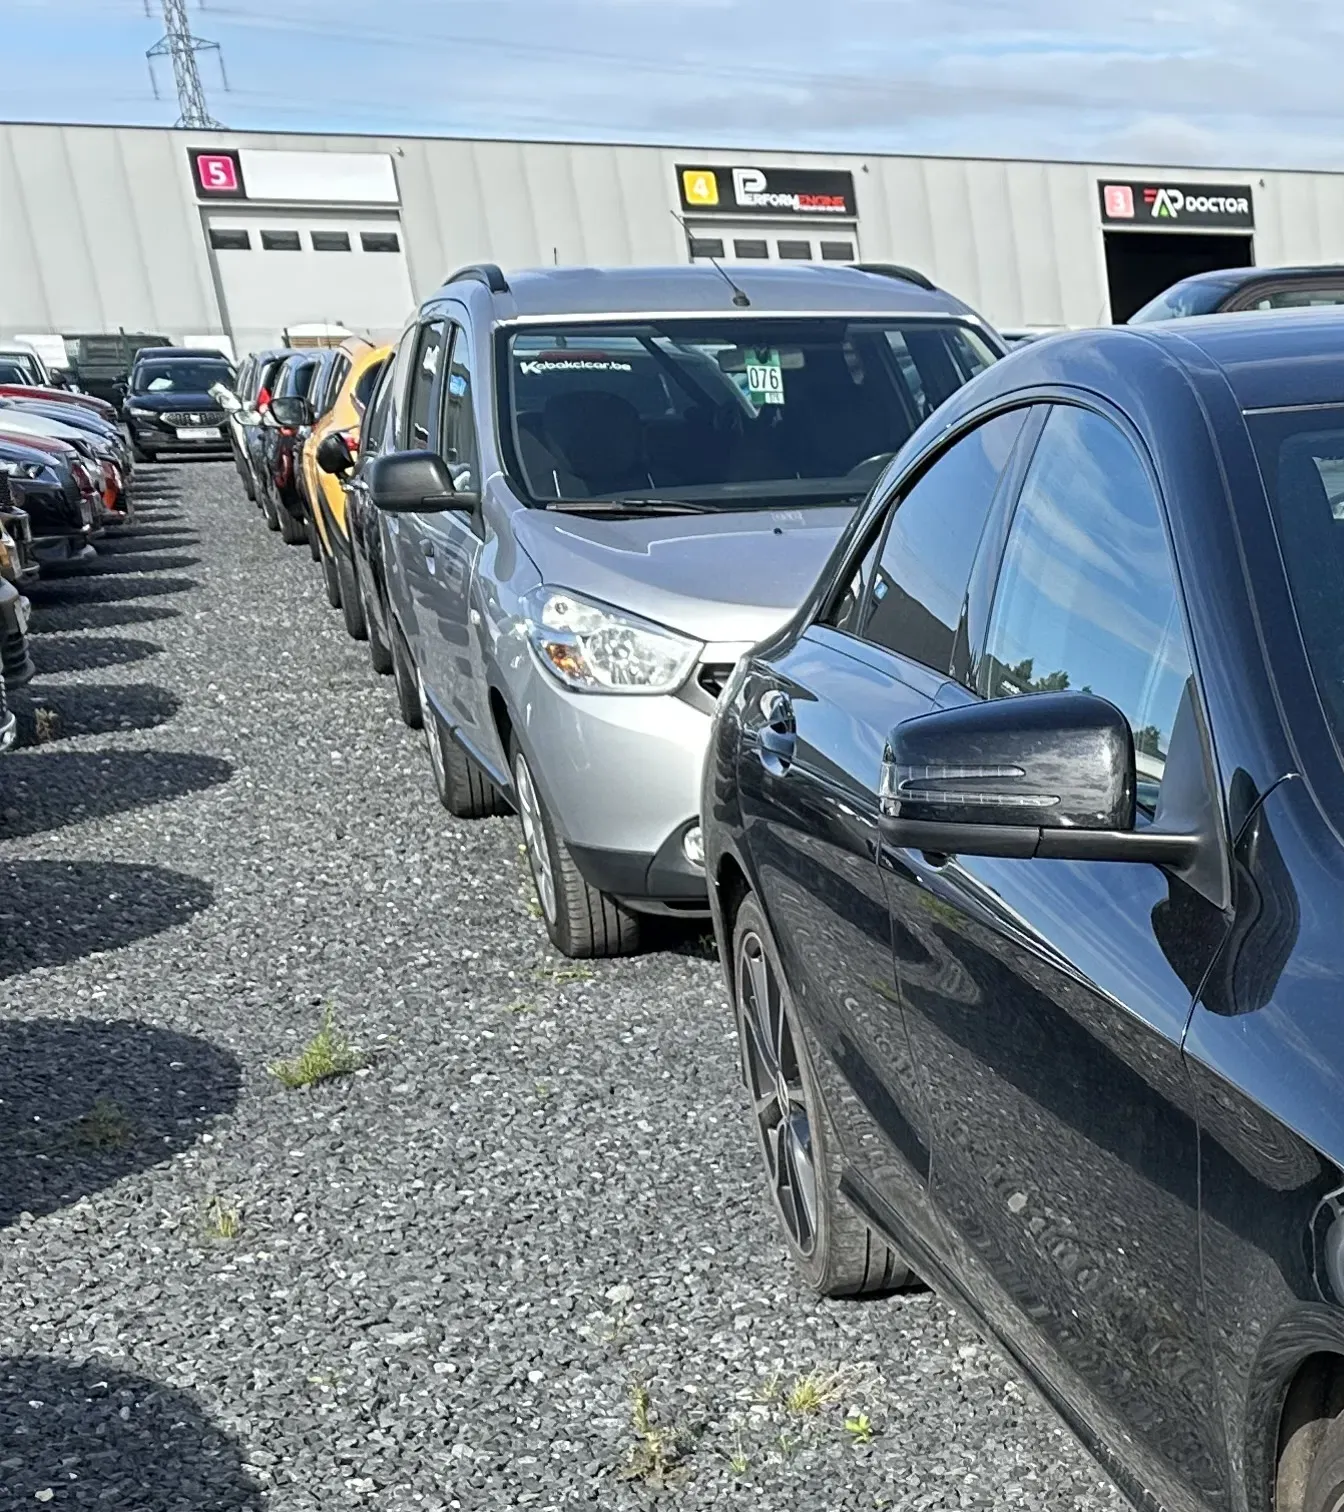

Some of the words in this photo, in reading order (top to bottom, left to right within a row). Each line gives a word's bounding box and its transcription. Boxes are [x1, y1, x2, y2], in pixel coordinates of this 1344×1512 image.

[209, 161, 227, 185] 5
[692, 176, 710, 198] 4
[1112, 191, 1126, 211] 3
[1186, 197, 1249, 213] DOCTOR
[750, 367, 779, 390] 076
